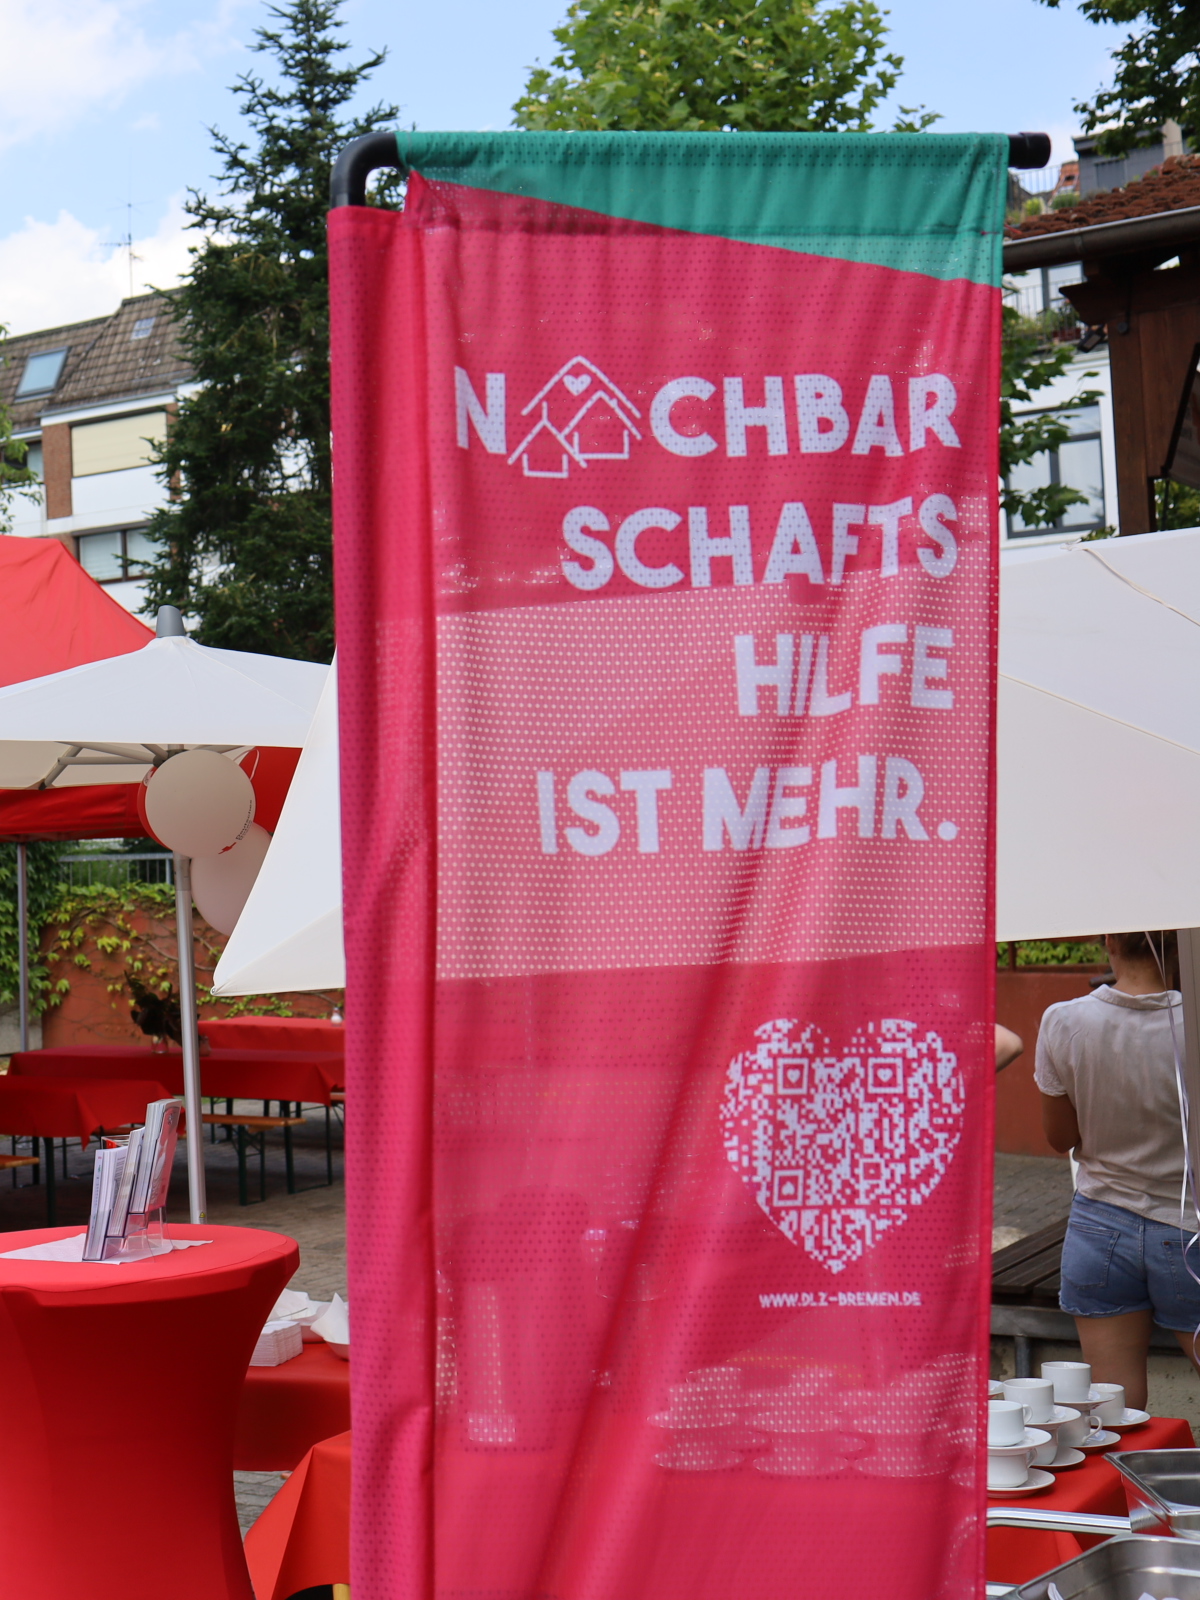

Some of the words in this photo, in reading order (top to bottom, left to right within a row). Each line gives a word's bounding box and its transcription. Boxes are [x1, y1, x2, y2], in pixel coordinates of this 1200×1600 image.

[562, 494, 957, 590] SCHAFTS
[734, 624, 954, 717] HILFE
[535, 769, 672, 856] IST
[702, 755, 959, 852] MEHR.
[758, 1291, 922, 1308] WWW.DLZ-BREMEN.DE
